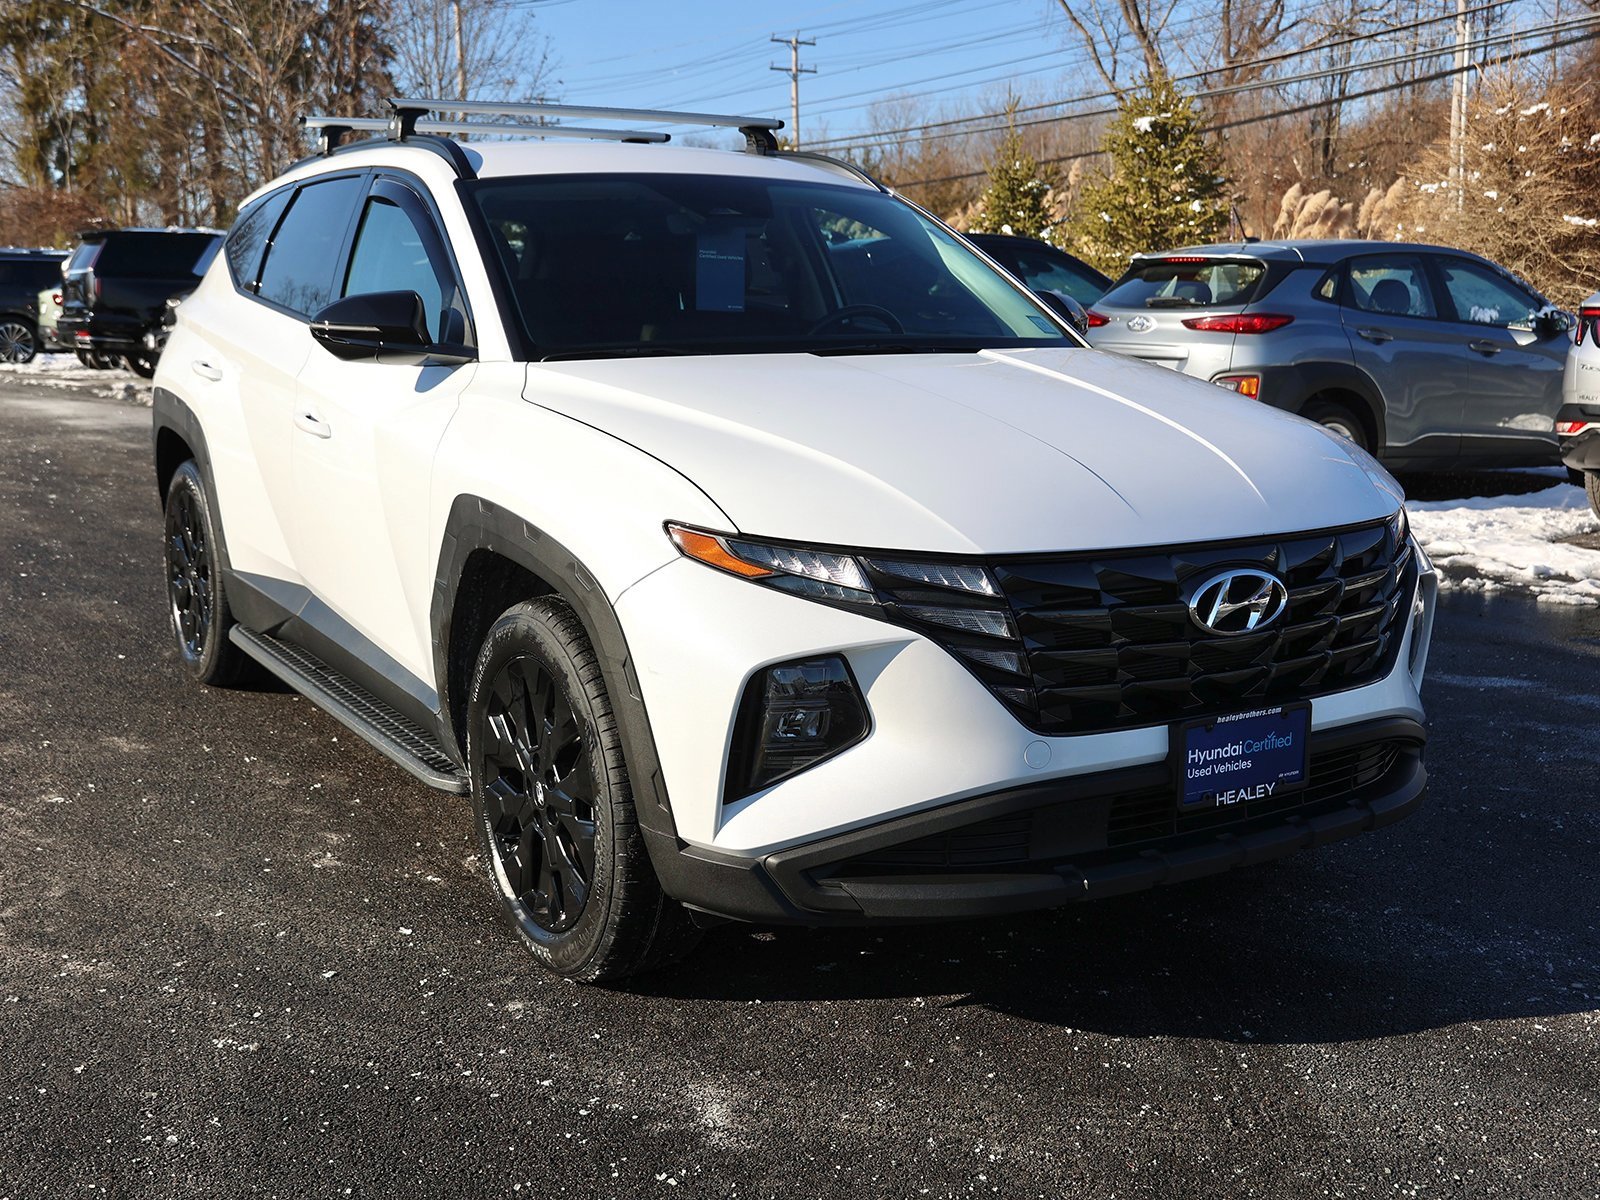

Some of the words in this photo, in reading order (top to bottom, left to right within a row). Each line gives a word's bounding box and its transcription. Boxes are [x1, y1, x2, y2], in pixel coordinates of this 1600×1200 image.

[1216, 706, 1282, 724] healeybrothers.com
[1188, 741, 1243, 765] Hyundai
[1243, 731, 1293, 754] Certified
[1187, 765, 1212, 779] Used
[1213, 759, 1252, 774] Vehicles
[1215, 782, 1276, 806] HEALEY
